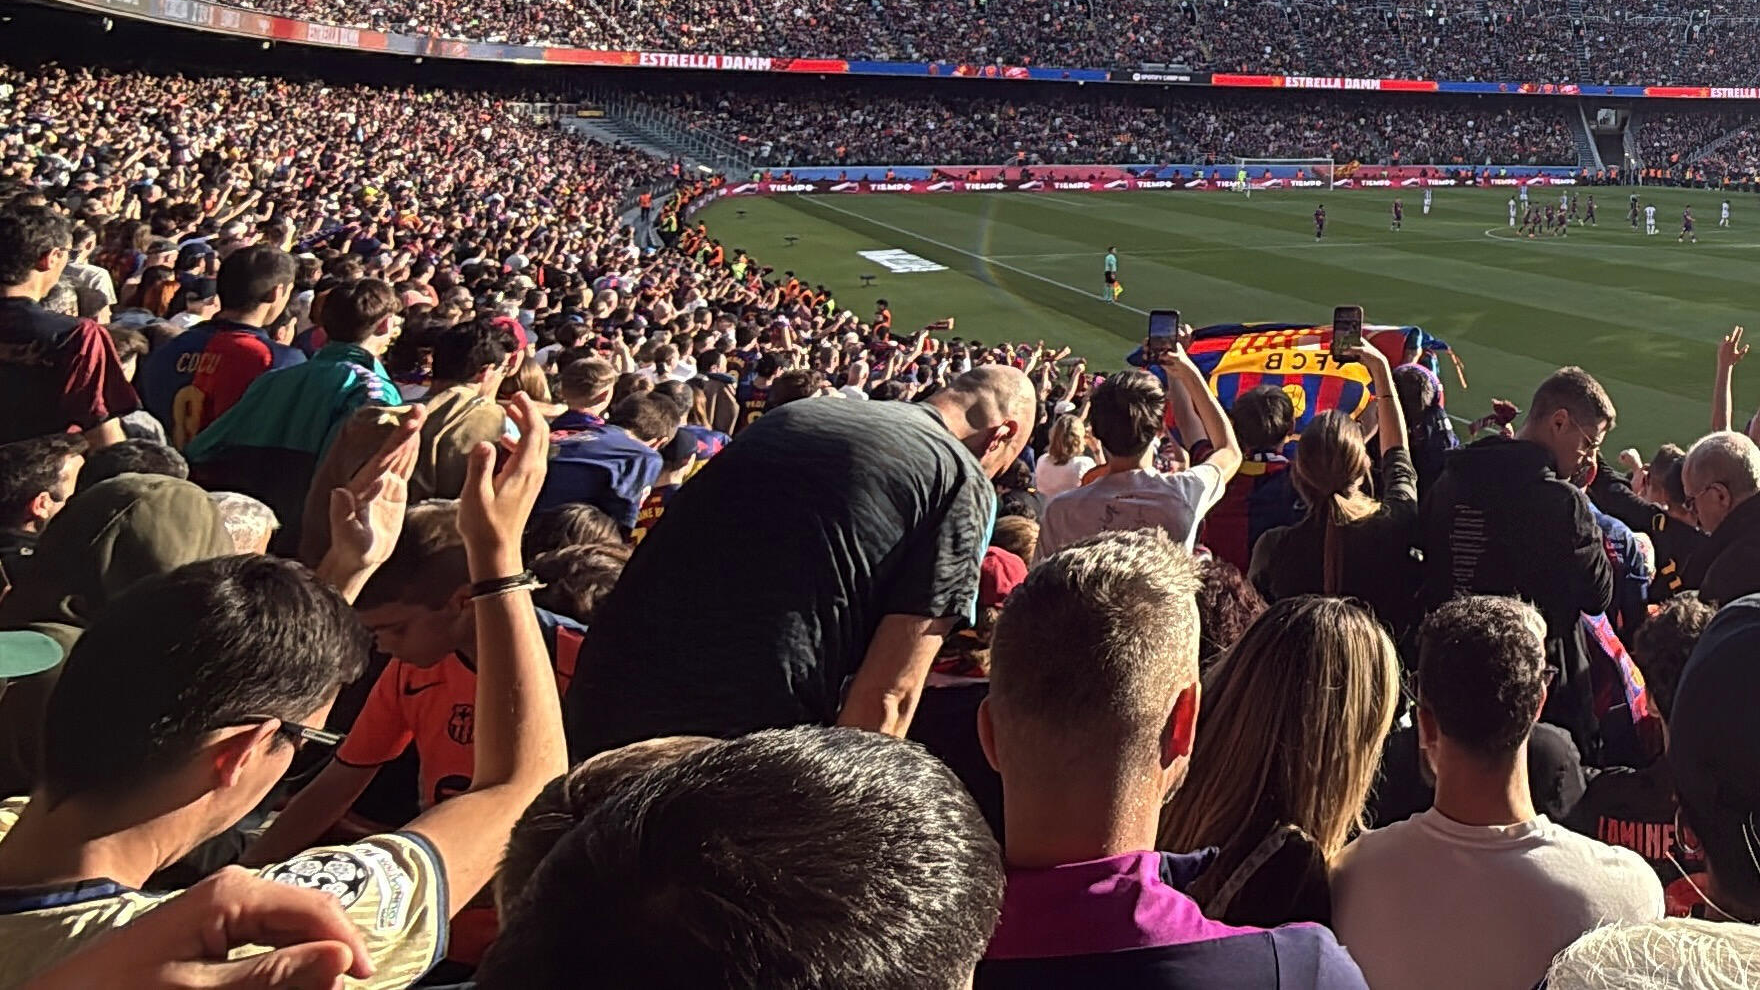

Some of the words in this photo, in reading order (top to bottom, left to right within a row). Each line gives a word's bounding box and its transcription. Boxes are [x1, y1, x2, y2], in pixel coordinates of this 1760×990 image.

[639, 52, 717, 69] ESTRELLA
[721, 56, 772, 71] DAMM
[1285, 76, 1342, 89] ESTRELLA
[1344, 78, 1381, 90] DAMM
[1710, 87, 1757, 99] ESTRELLA
[964, 182, 1004, 190] TIEMPO
[1137, 180, 1173, 188] TIEMPO
[1361, 179, 1391, 187] TIEMPO
[1427, 178, 1455, 186] TIEMPO
[1490, 178, 1518, 186] TIEMPO
[1550, 178, 1576, 186] TIEMPO
[769, 183, 814, 192] TIEMPO
[869, 183, 913, 192] TIEMPO
[176, 352, 222, 374] COCU
